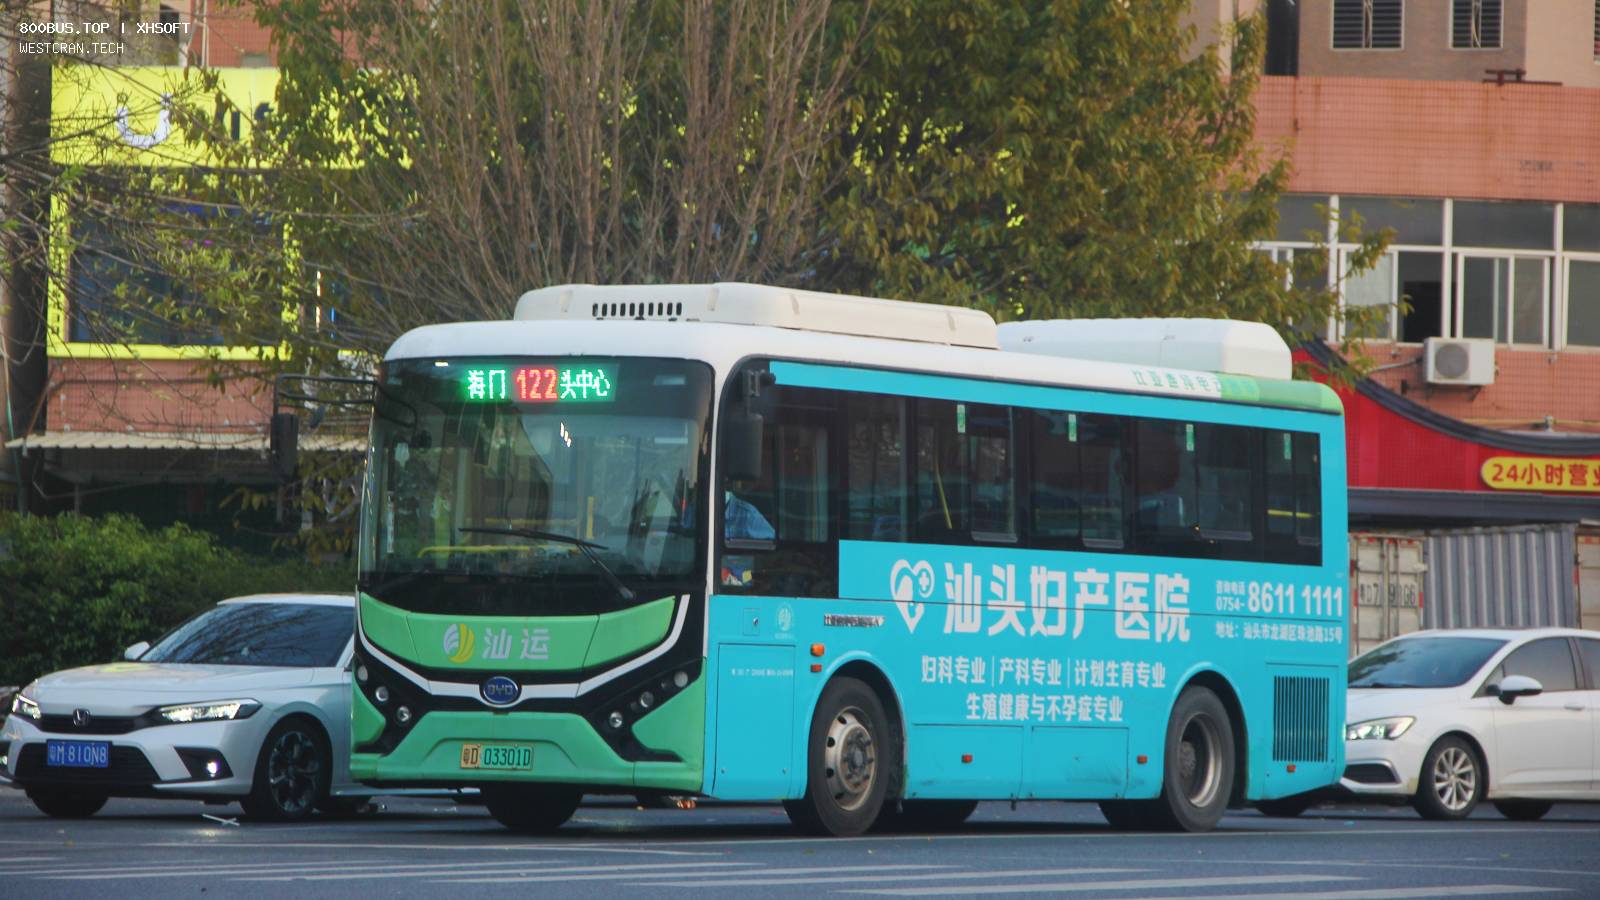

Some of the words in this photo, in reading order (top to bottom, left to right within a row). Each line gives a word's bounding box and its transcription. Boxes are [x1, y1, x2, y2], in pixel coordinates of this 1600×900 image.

[467, 369, 506, 400] 海门
[516, 369, 558, 400] 122
[560, 369, 611, 400] 头中心
[943, 561, 1191, 643] 汕头妇产医院
[1215, 596, 1246, 612] 0754-
[1248, 581, 1295, 615] 8611
[1301, 584, 1343, 617] 1111
[481, 627, 549, 660] 汕运
[921, 655, 986, 684] 妇科专业
[999, 657, 1062, 687] 产科专业
[1074, 659, 1166, 689] 计划生育专业
[965, 692, 1124, 722] 生殖健康与不孕症专业
